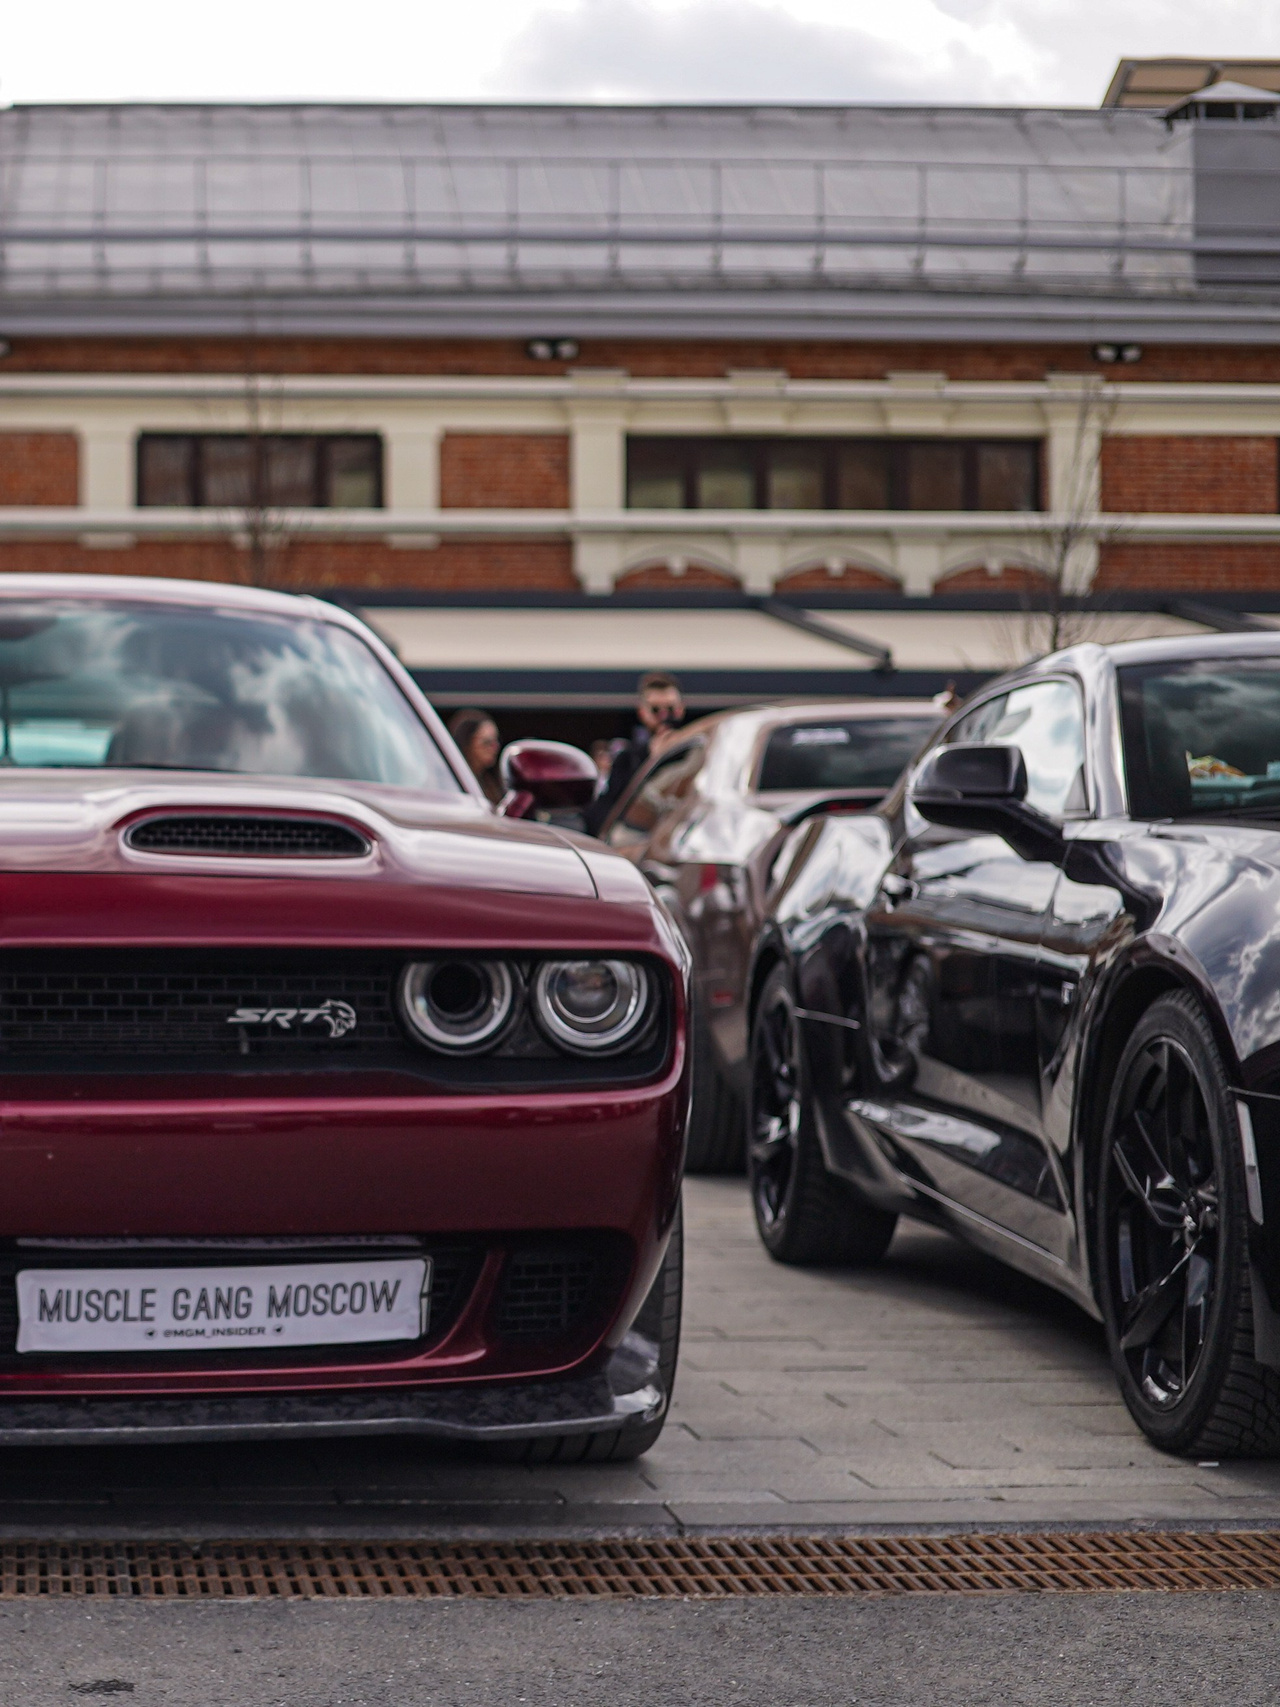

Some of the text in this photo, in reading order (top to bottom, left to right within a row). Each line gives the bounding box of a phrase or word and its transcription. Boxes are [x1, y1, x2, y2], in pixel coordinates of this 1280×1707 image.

[226, 1008, 330, 1028] SRT
[38, 1279, 402, 1323] MUSCLE GANG MOSCOW
[163, 1326, 267, 1338] @MGM_INSIDER
